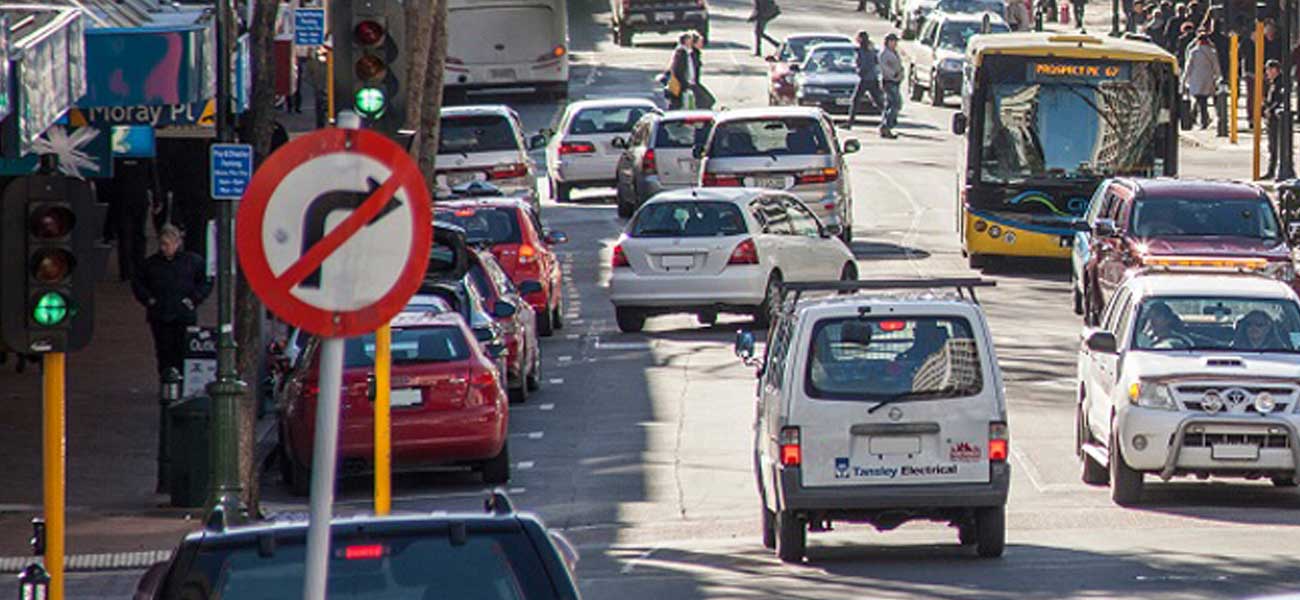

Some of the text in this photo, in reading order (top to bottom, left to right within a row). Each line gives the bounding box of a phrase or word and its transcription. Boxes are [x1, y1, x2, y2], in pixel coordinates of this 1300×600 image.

[89, 103, 195, 127] Moray Pl
[853, 464, 958, 479] Tansley Electrical
